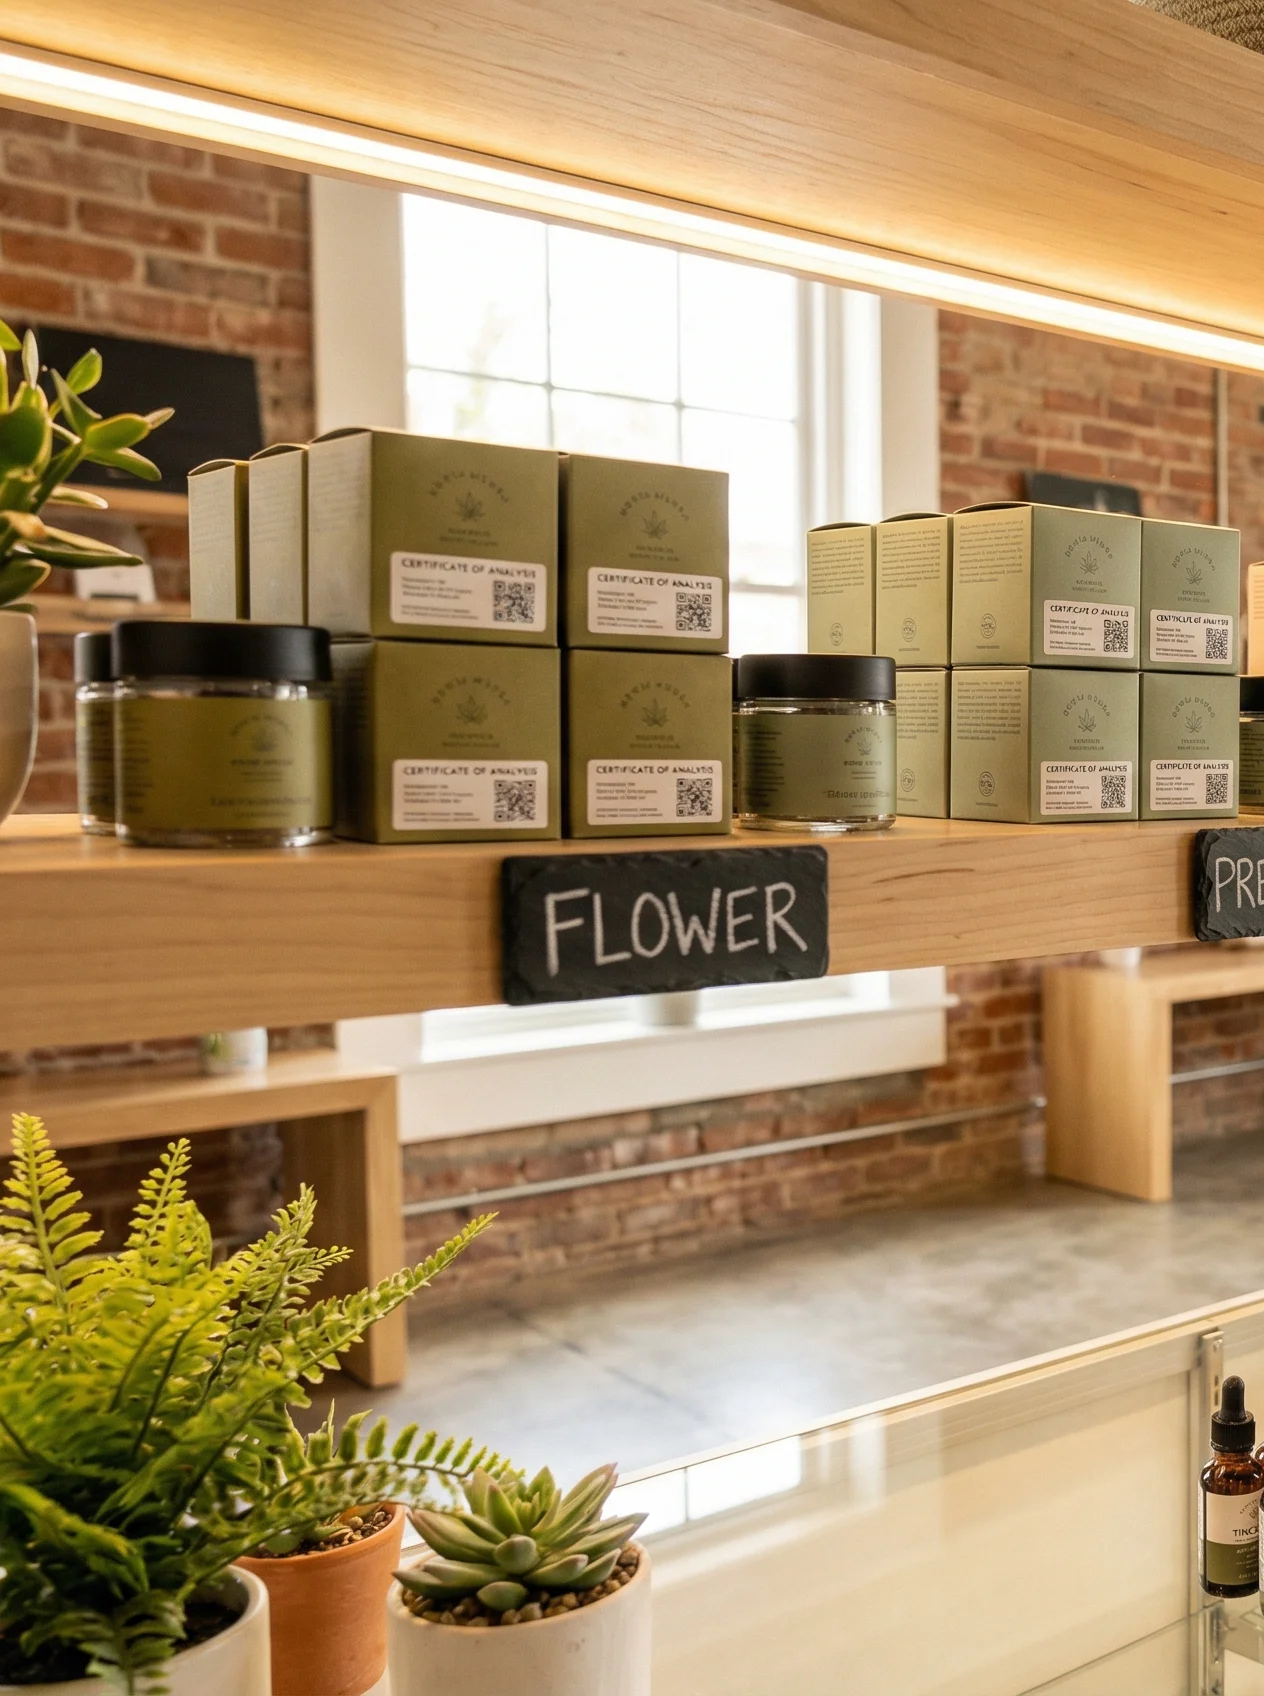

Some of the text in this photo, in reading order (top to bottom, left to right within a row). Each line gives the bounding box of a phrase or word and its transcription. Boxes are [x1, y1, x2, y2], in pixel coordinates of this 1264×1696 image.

[401, 558, 537, 578] CERTIFICATE OF ANALYSIS
[597, 574, 655, 587] CERTIFICATE
[657, 578, 669, 587] OF
[403, 766, 538, 776] CERTIFICATE OF ANALYSIS
[596, 765, 654, 774] CERTIFICATE
[657, 766, 669, 774] OF
[544, 881, 808, 978] FLOWER
